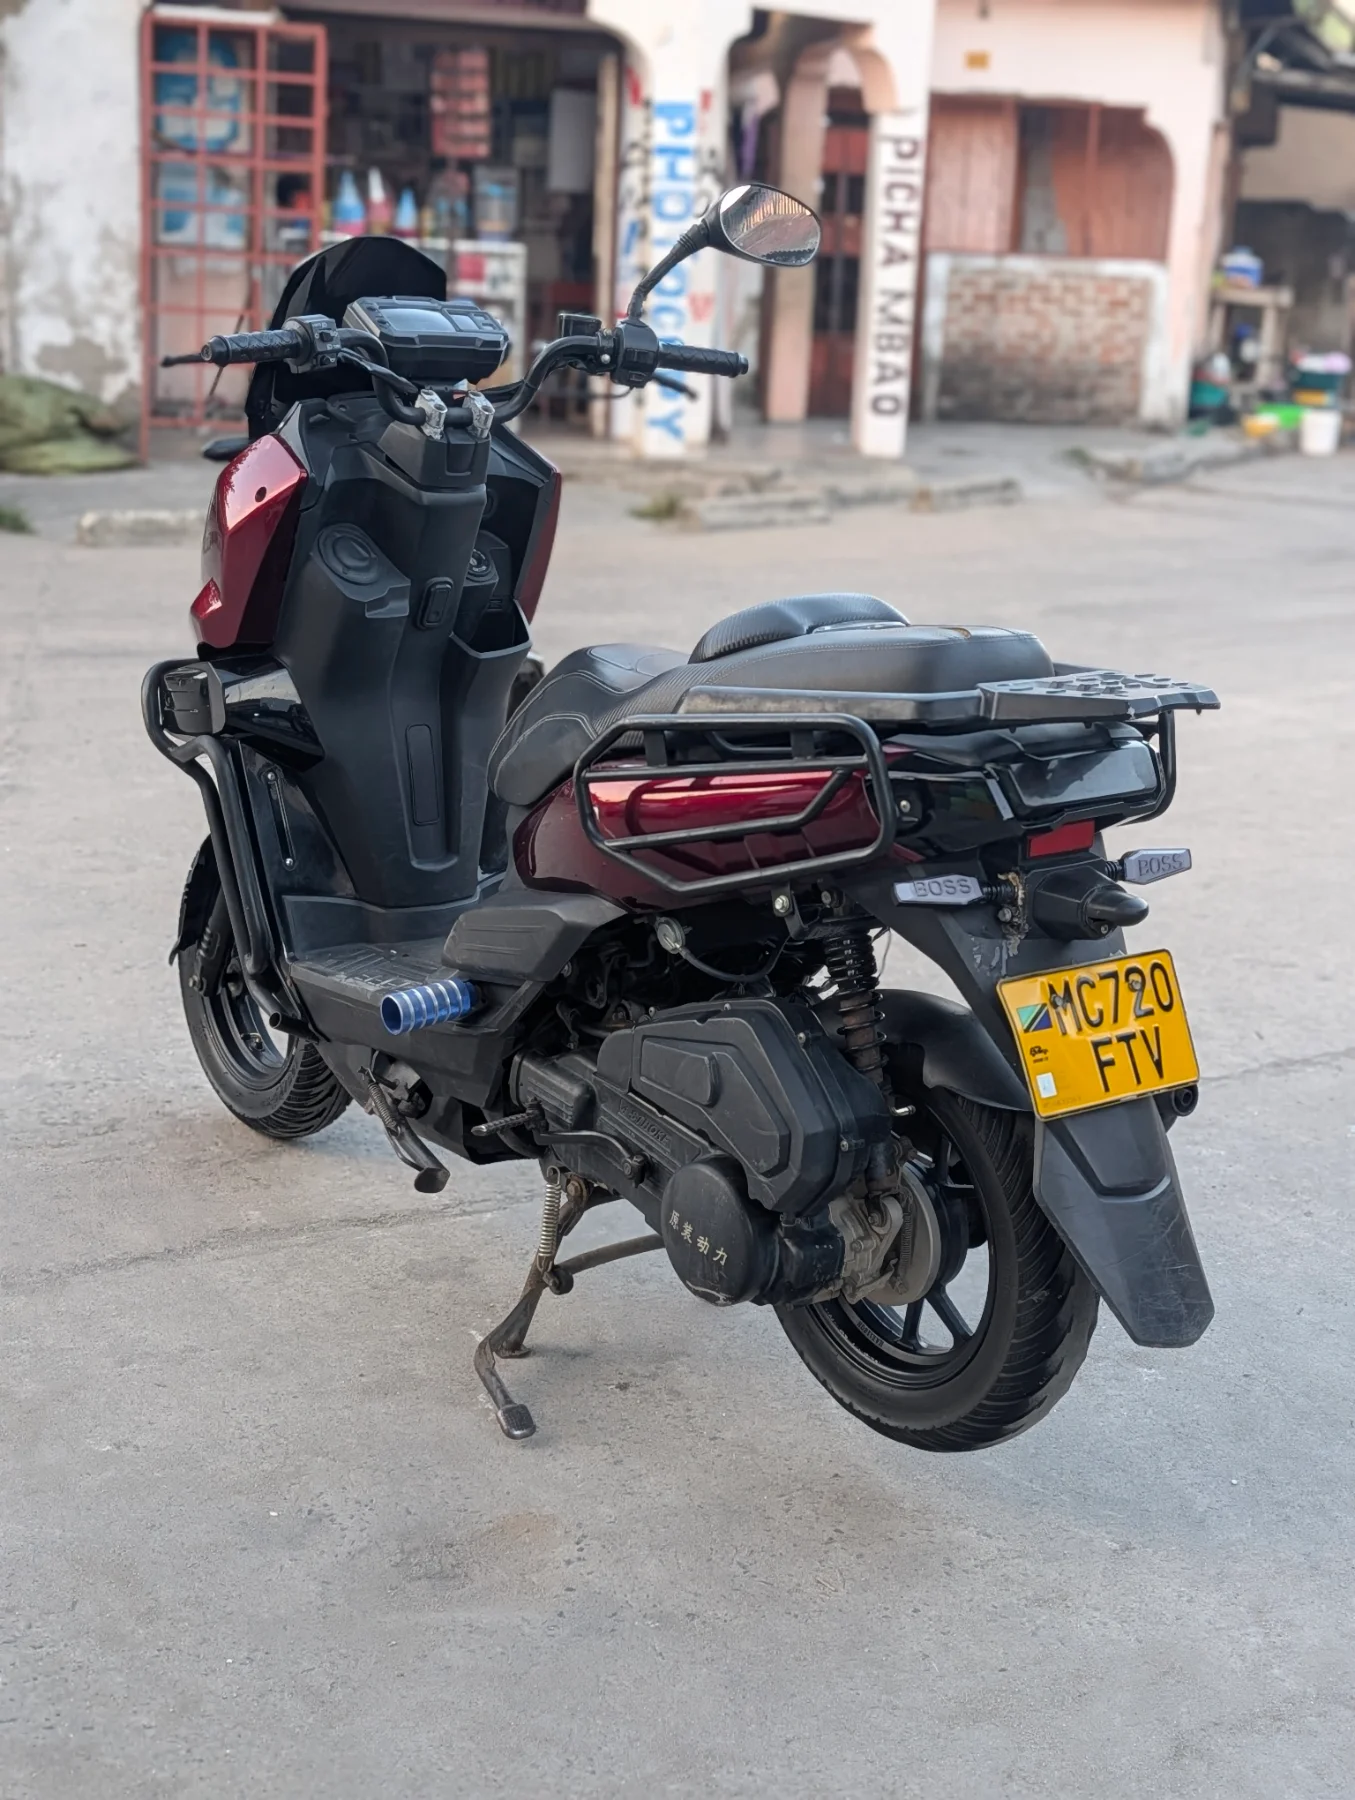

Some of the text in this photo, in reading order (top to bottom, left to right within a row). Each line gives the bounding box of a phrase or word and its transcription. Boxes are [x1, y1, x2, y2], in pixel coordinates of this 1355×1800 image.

[646, 101, 696, 442] PHOTOCPY
[872, 136, 919, 417] PICHA MBAO
[913, 878, 972, 898] BOSS
[1138, 853, 1183, 877] BOSS
[1048, 962, 1174, 1036] MC720
[1090, 1025, 1164, 1093] FTV
